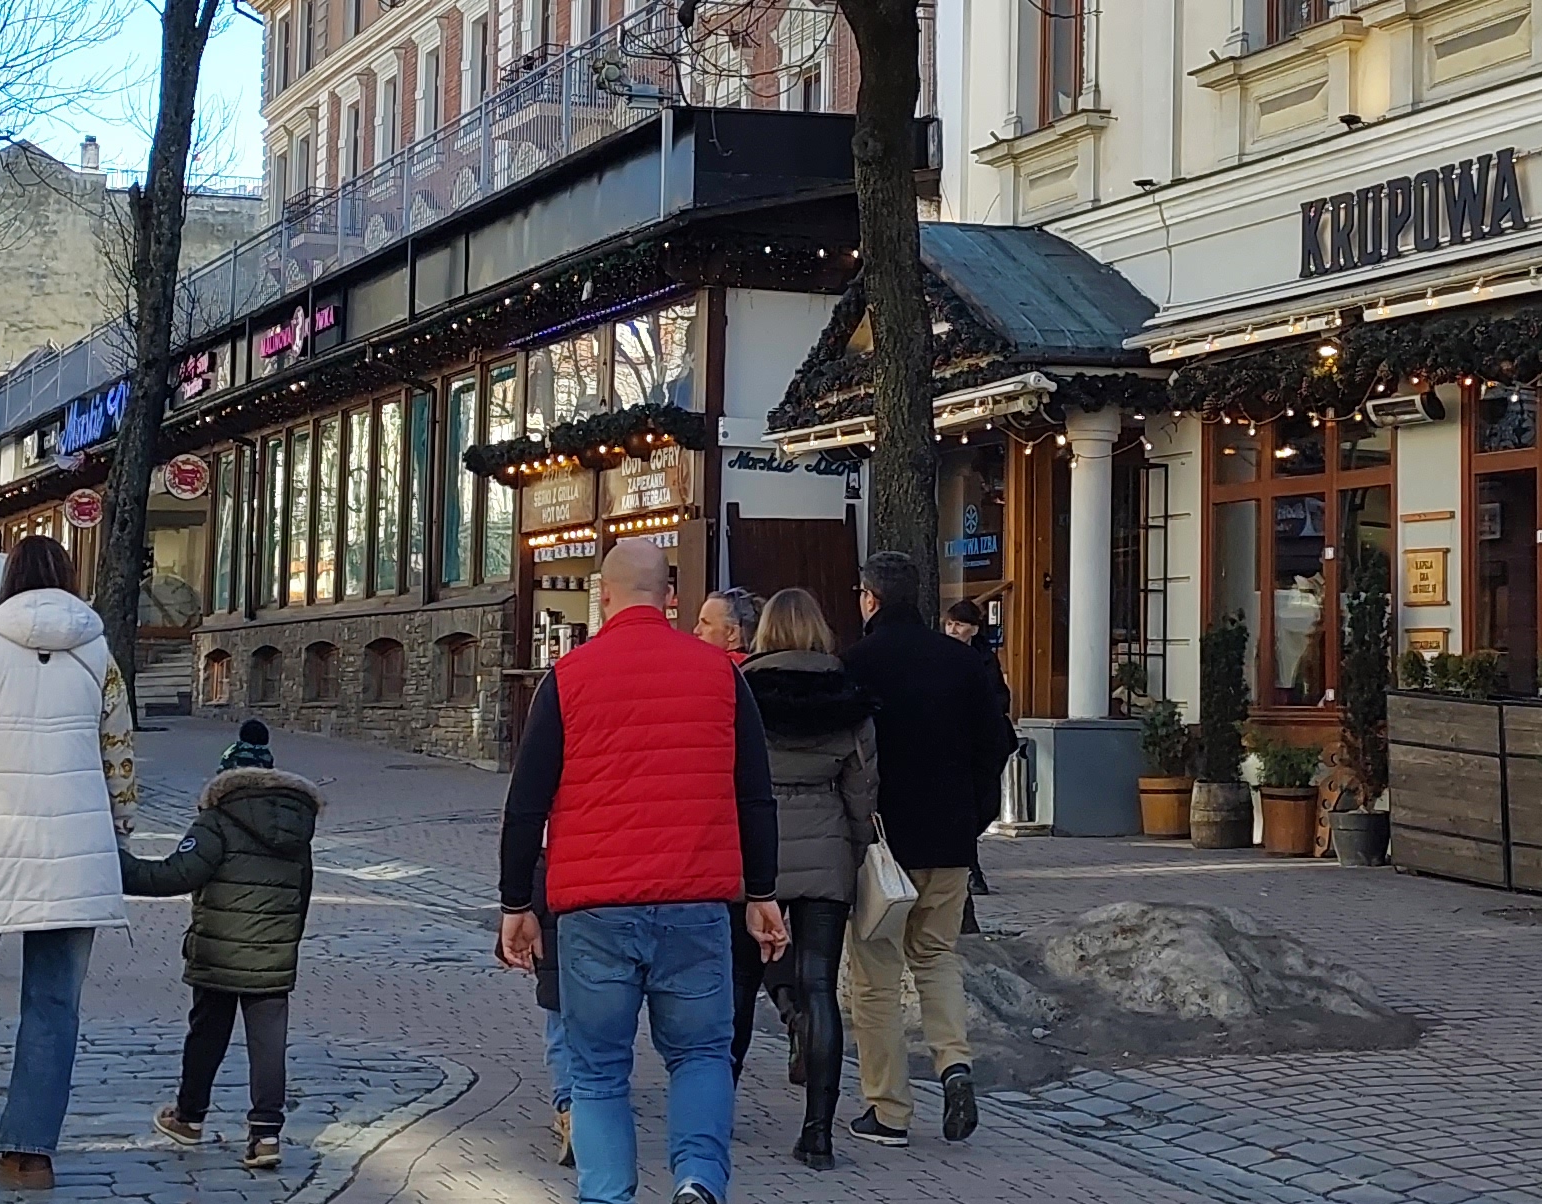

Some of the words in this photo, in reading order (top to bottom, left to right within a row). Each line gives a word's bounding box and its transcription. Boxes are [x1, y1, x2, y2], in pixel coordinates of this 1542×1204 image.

[1299, 147, 1527, 279] KRUPOWA
[650, 445, 680, 470] GOFRY
[621, 494, 639, 511] KAWA
